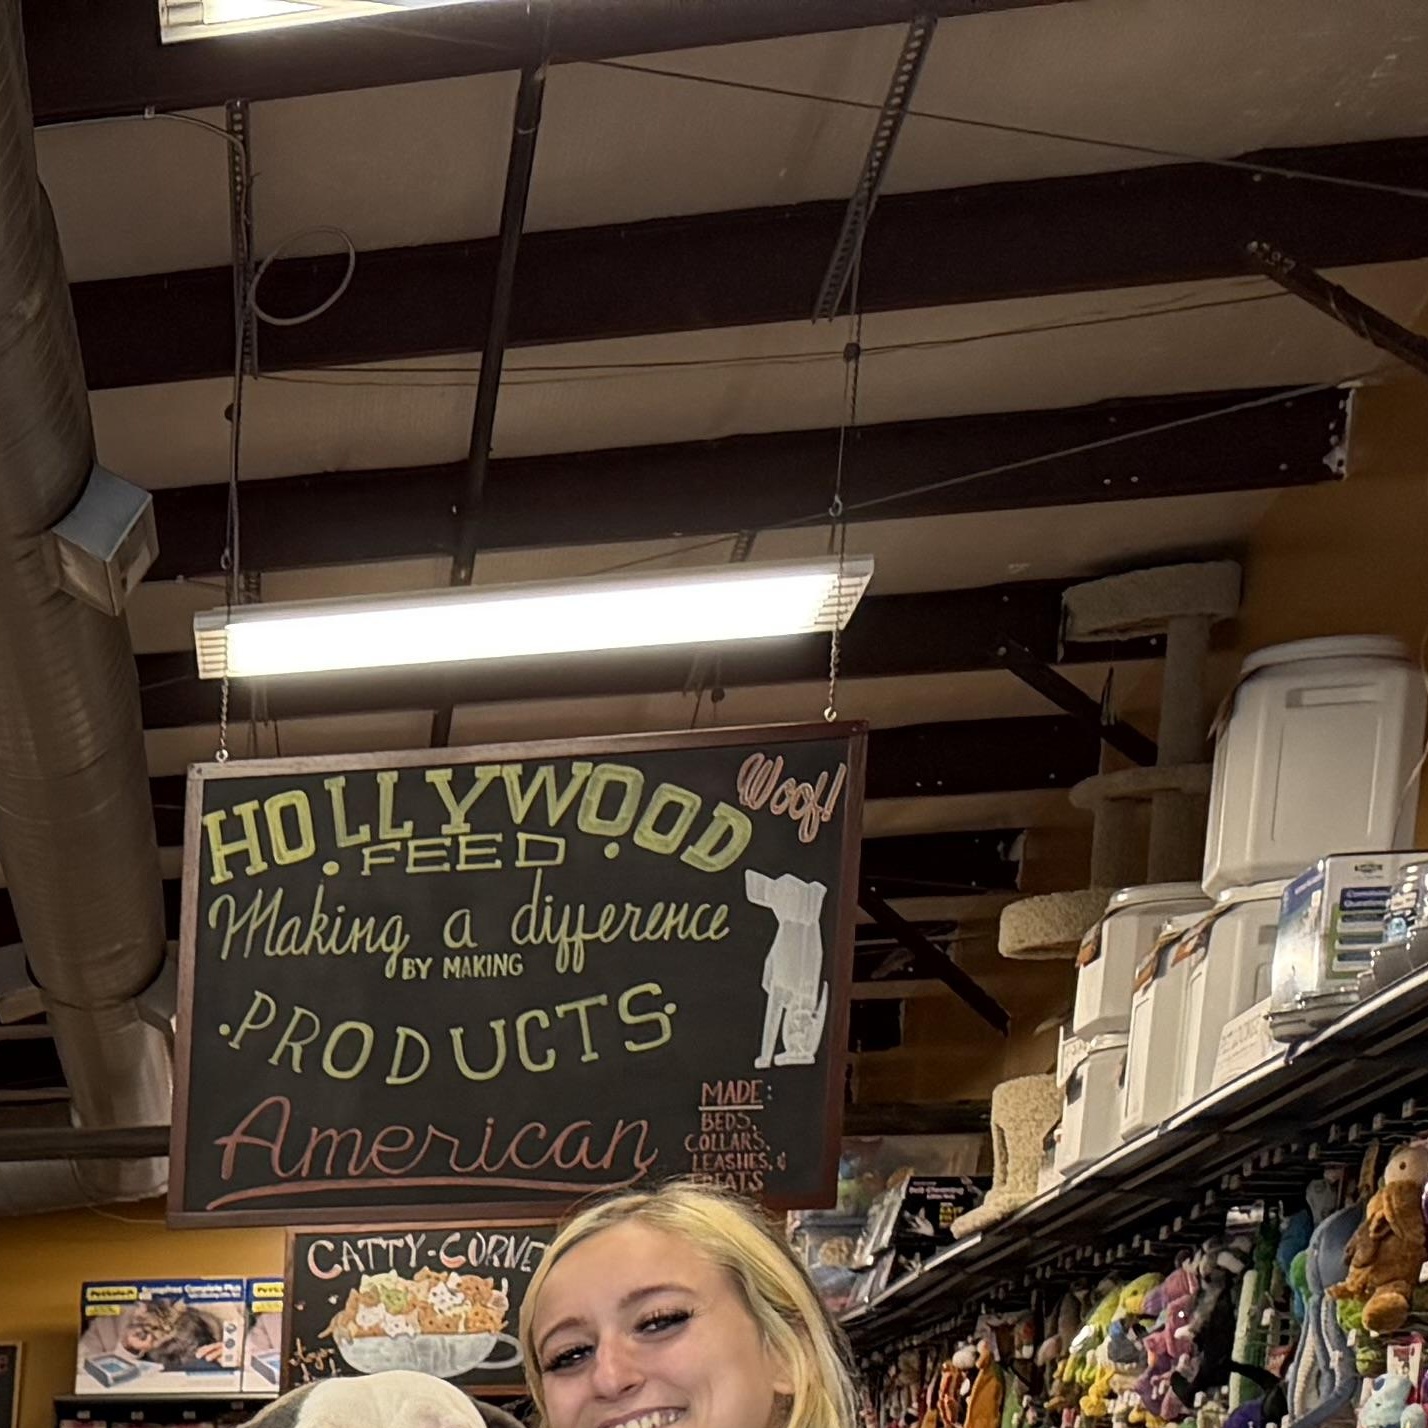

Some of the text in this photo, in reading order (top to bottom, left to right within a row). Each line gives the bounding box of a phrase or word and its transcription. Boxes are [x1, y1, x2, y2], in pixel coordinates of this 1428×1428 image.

[203, 762, 753, 885] HOLLYWOOD
[737, 752, 846, 843] Woof!
[361, 833, 565, 875] FEED
[207, 868, 730, 979] Making a difference
[402, 954, 524, 980] BY MAKING
[229, 982, 672, 1085] PRODUCTS
[213, 1095, 659, 1180] American
[307, 1232, 549, 1279] CATTY-CORNE
